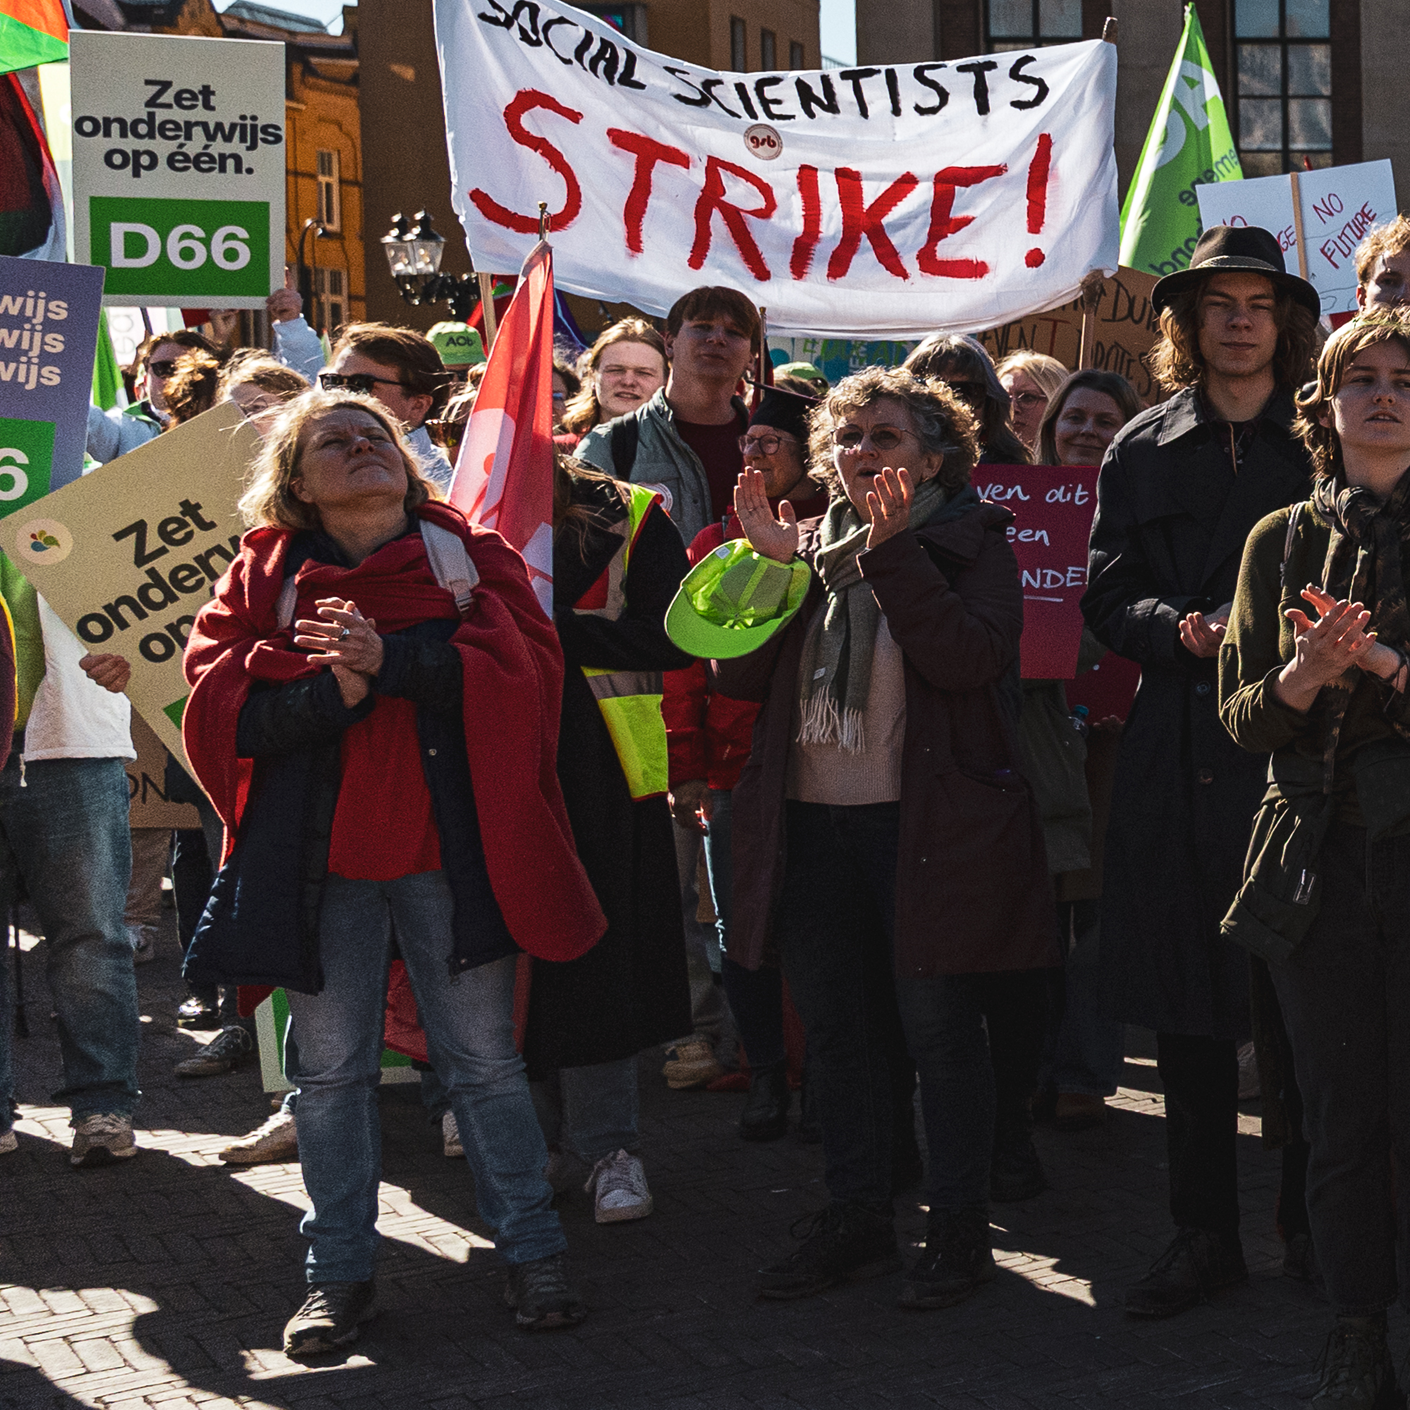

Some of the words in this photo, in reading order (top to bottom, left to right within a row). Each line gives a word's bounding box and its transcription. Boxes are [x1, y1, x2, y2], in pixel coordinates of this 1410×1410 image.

[143, 79, 216, 111] Zet
[663, 55, 1049, 121] SCIENTISTS
[74, 111, 283, 152] onderwijs
[103, 148, 159, 178] op
[166, 142, 255, 176] één.
[469, 88, 1053, 282] STRIKE!
[1312, 192, 1344, 225] NO
[110, 221, 251, 271] D66
[1319, 200, 1378, 270] FUTURE
[1045, 484, 1090, 505] dit
[111, 499, 218, 568] Zet
